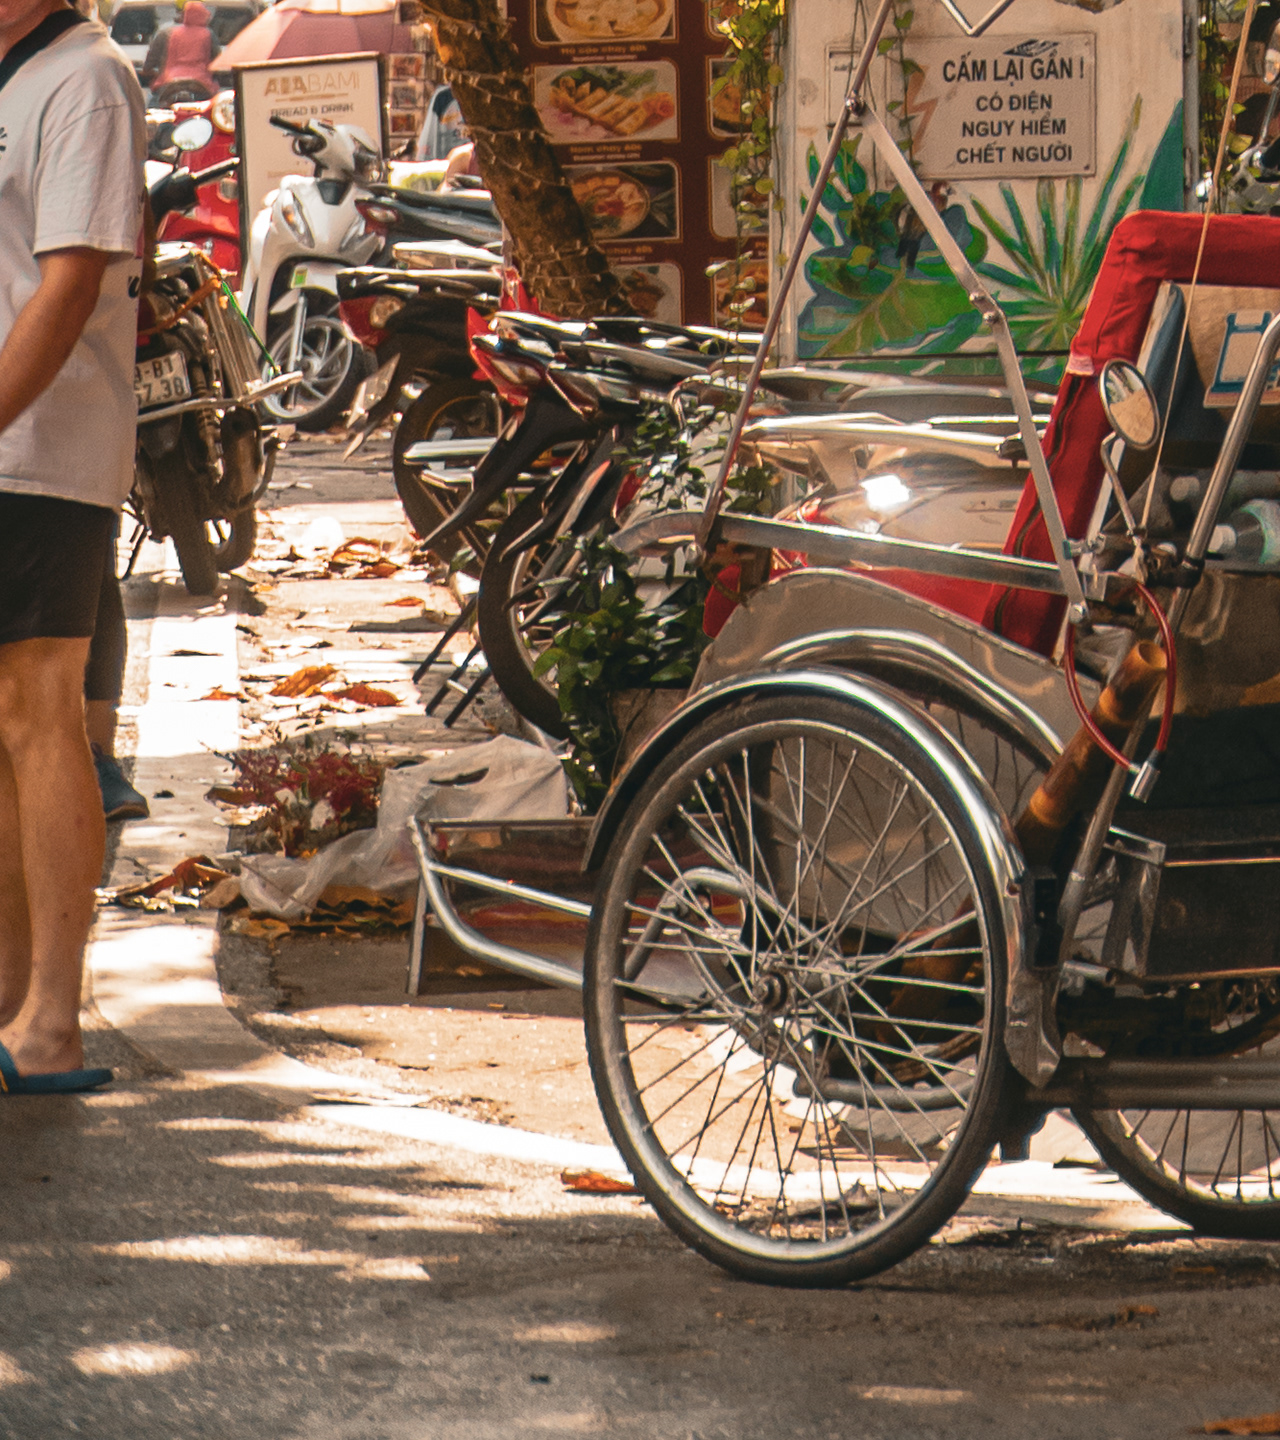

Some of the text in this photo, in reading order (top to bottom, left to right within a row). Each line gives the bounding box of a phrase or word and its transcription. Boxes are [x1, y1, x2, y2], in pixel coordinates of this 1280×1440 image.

[993, 58, 1024, 87] LẠI
[975, 89, 1052, 114] CÓ ĐIỆN
[961, 119, 1015, 137] NGUY
[956, 140, 1006, 163] CHẾT
